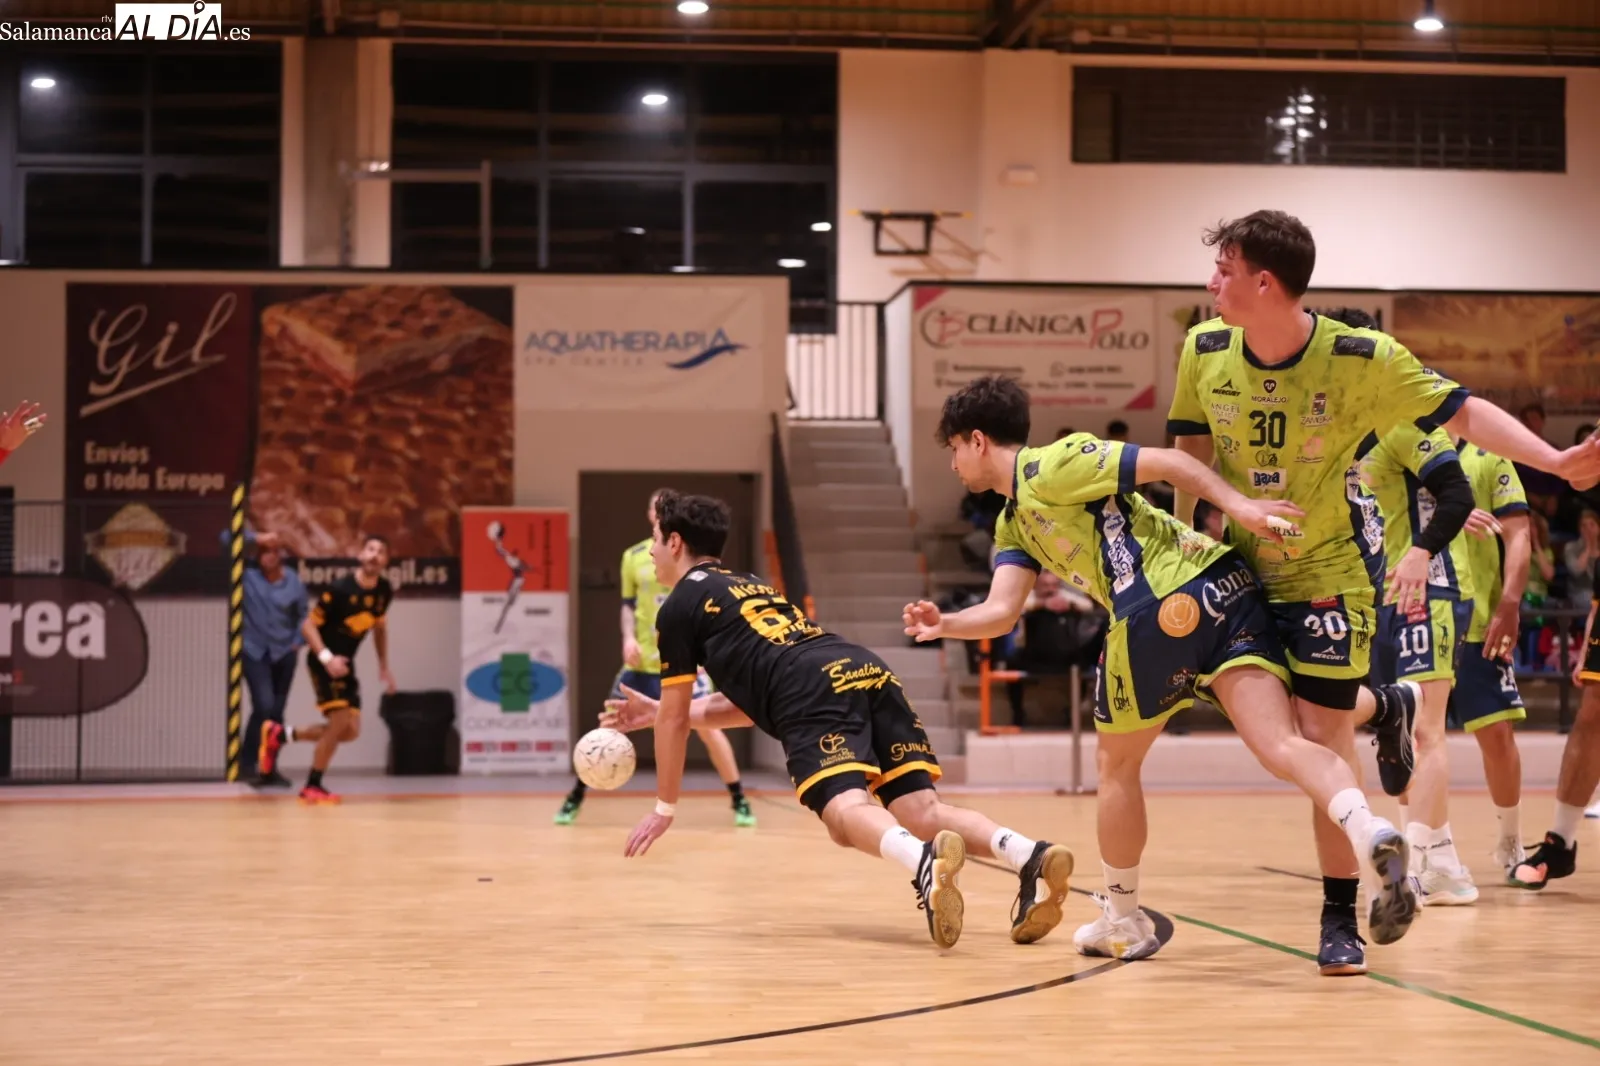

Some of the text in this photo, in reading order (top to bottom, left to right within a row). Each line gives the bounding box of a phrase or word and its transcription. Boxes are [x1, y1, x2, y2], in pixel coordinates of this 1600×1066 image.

[966, 310, 1086, 335] CLÍNICA
[526, 328, 733, 354] AQUATHERAPIA
[1212, 388, 1242, 397] MERCURY
[1248, 410, 1286, 448] 30
[104, 466, 149, 489] toda
[156, 467, 225, 496] Europa
[1304, 610, 1347, 641] 30
[1399, 624, 1429, 658] 10
[1311, 652, 1346, 661] MERCURY
